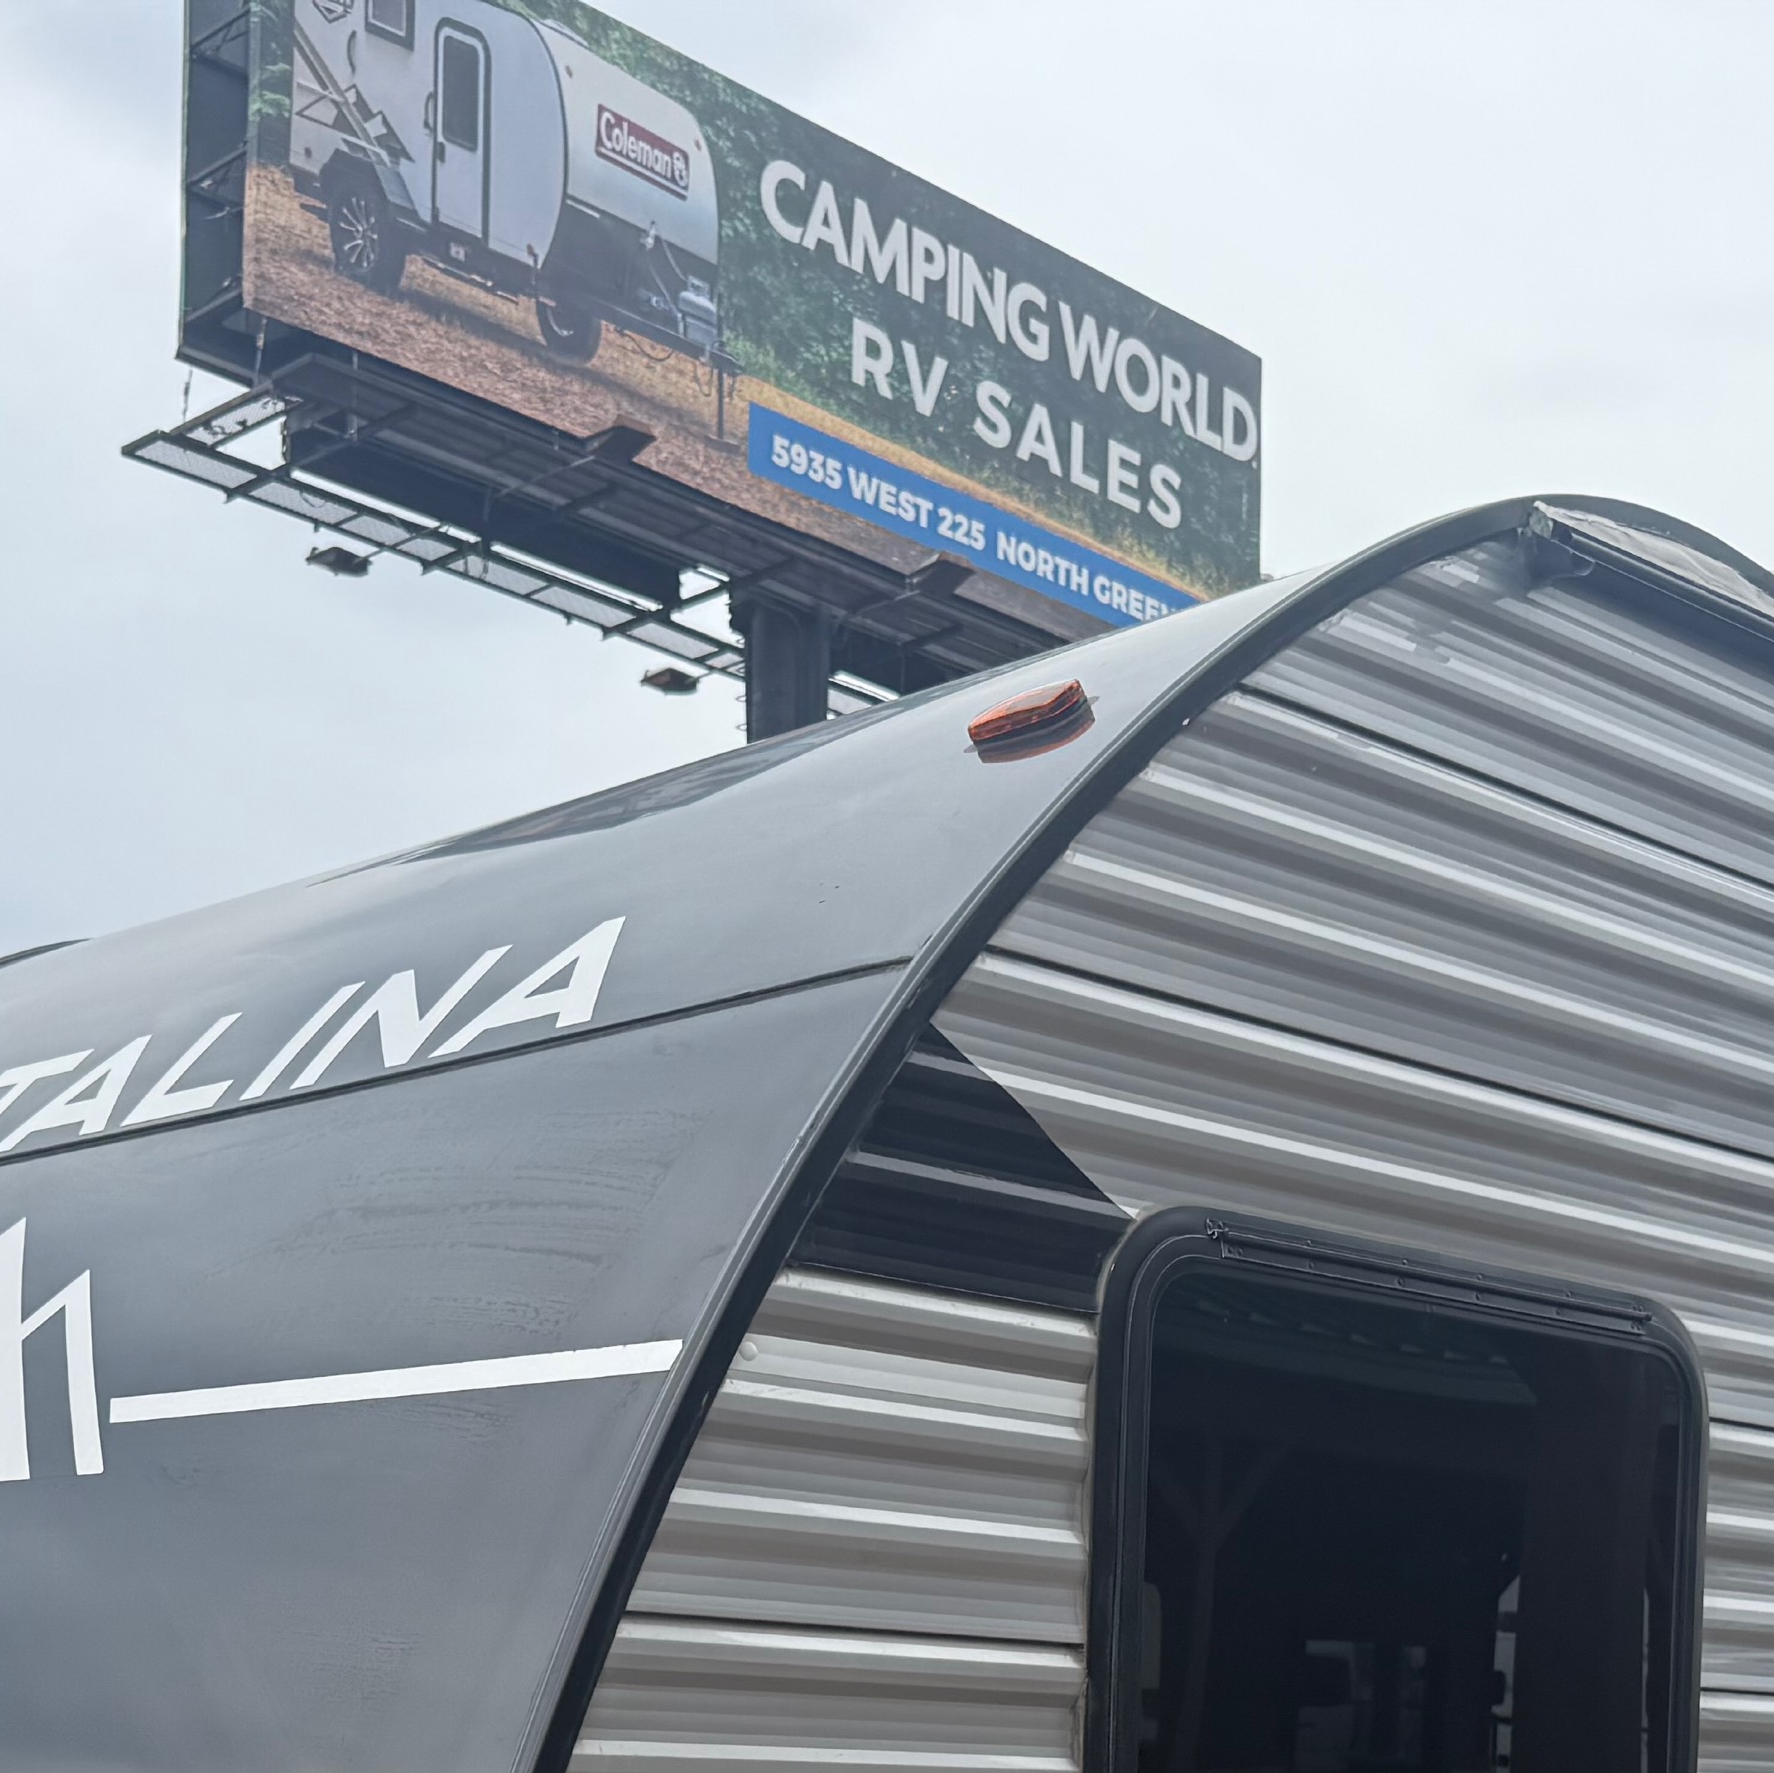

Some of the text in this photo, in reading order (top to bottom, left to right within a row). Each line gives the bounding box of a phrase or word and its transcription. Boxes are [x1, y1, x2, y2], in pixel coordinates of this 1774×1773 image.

[600, 111, 672, 178] Coleman
[760, 159, 1258, 462] CAMPING WORLD
[770, 434, 843, 490] 5935
[846, 465, 934, 529] WEST
[936, 507, 987, 551] 225
[996, 530, 1089, 596] NORTH
[850, 317, 1183, 529] RV SALES
